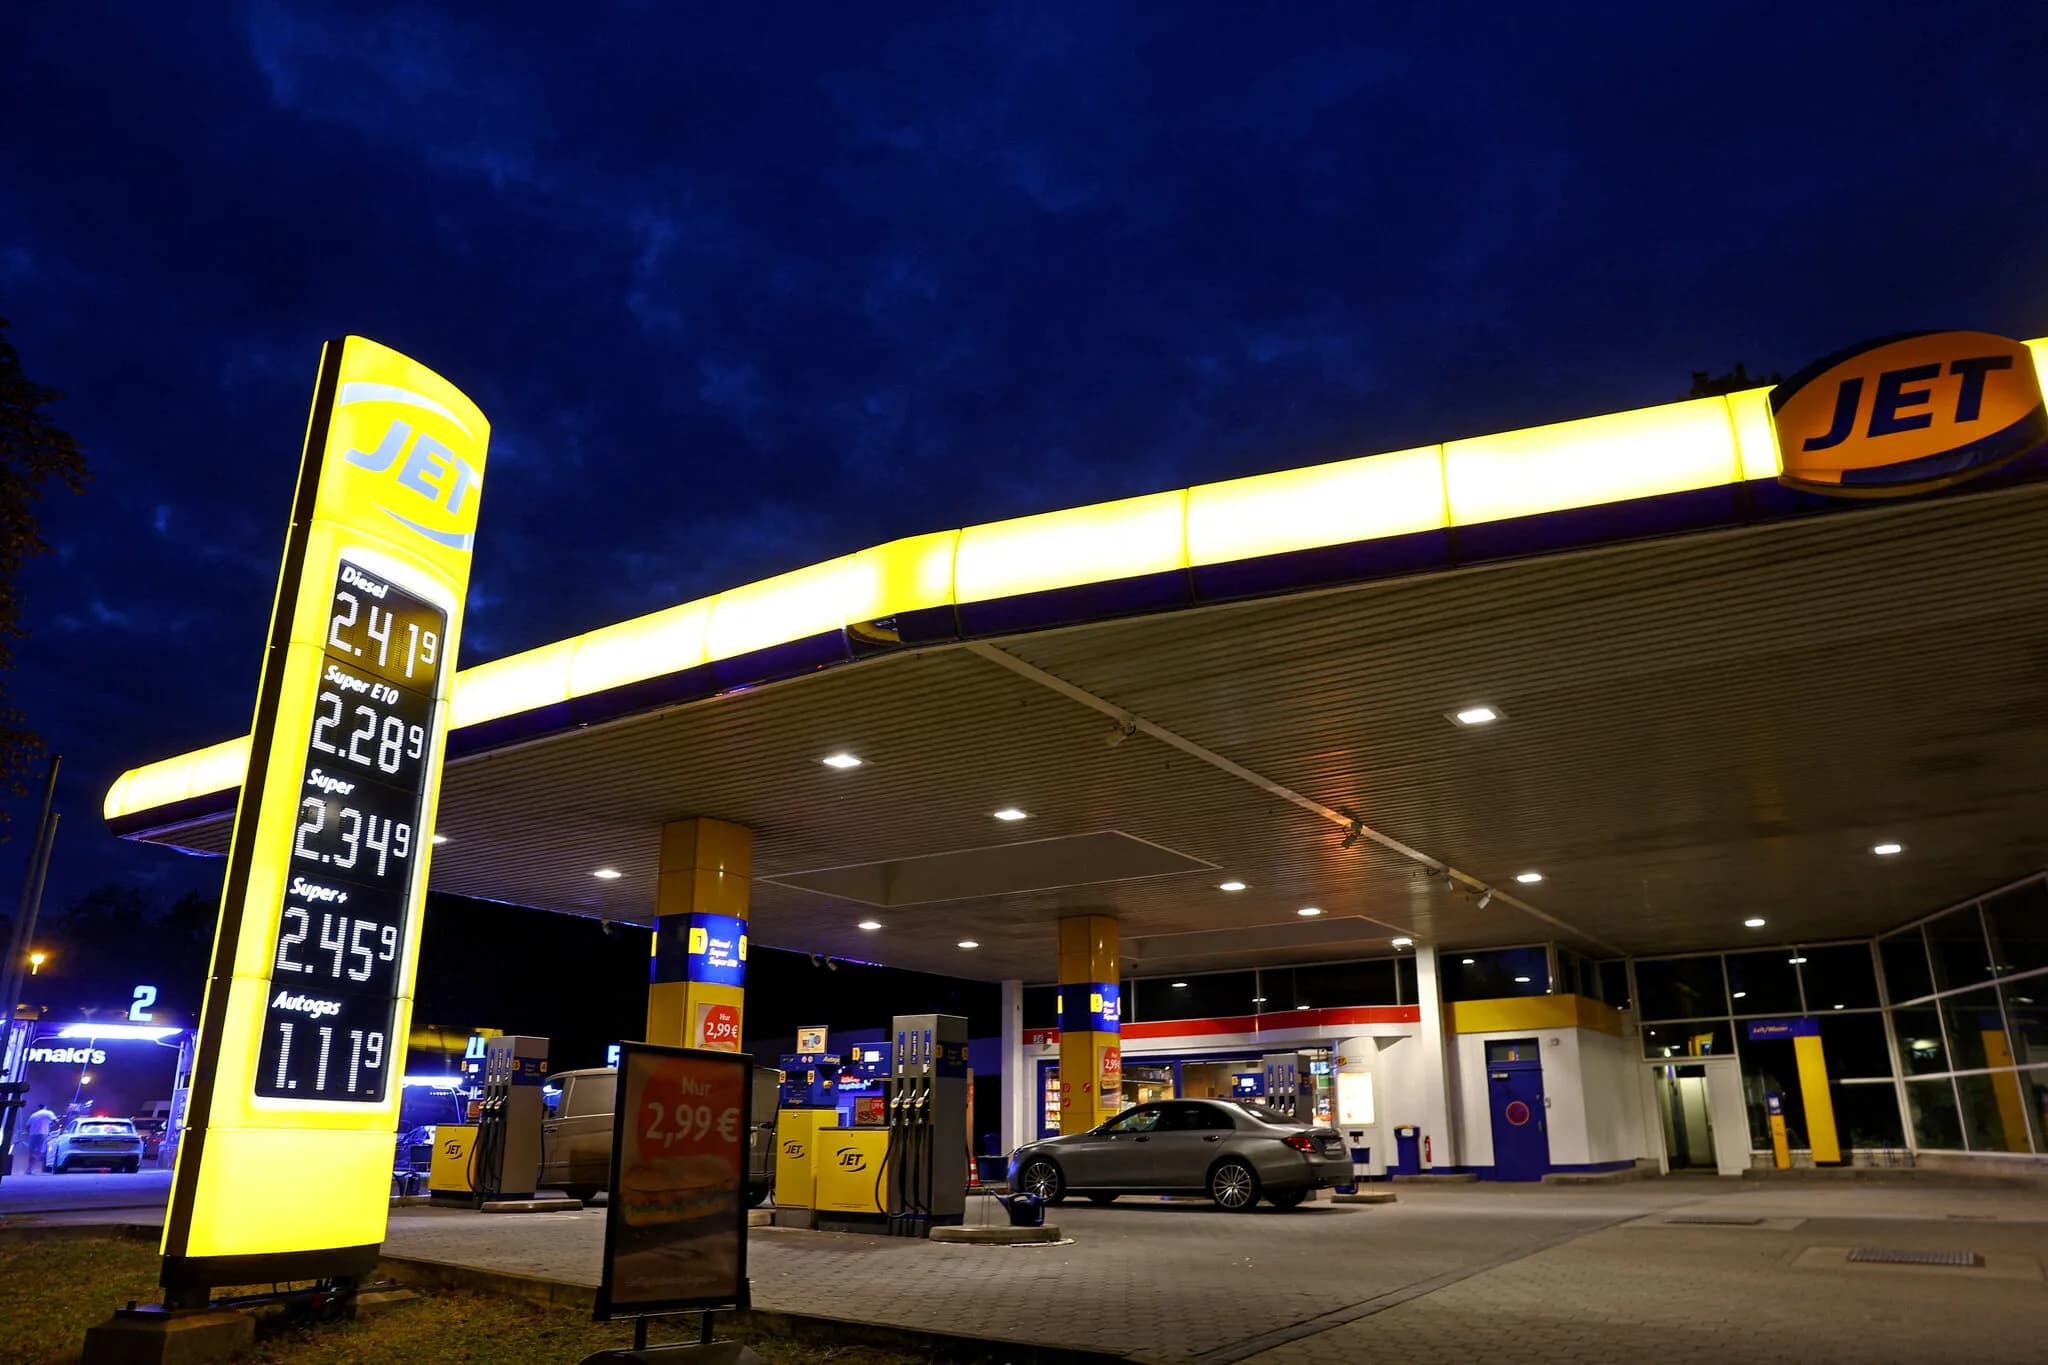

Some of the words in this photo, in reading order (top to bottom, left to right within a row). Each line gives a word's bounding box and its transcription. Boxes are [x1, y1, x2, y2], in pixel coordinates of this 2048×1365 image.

[1801, 354, 2013, 452] JET
[344, 419, 481, 515] JET
[341, 566, 389, 599] Diesel
[324, 664, 370, 694] Super
[370, 682, 399, 705] E10
[307, 768, 356, 796] Super
[289, 877, 348, 903] Super+
[128, 985, 157, 1022] 2
[271, 990, 342, 1019] Autogas
[681, 1075, 712, 1096] Nur
[445, 1144, 462, 1155] JET
[785, 1144, 803, 1154] JET
[839, 1153, 864, 1166] JET
